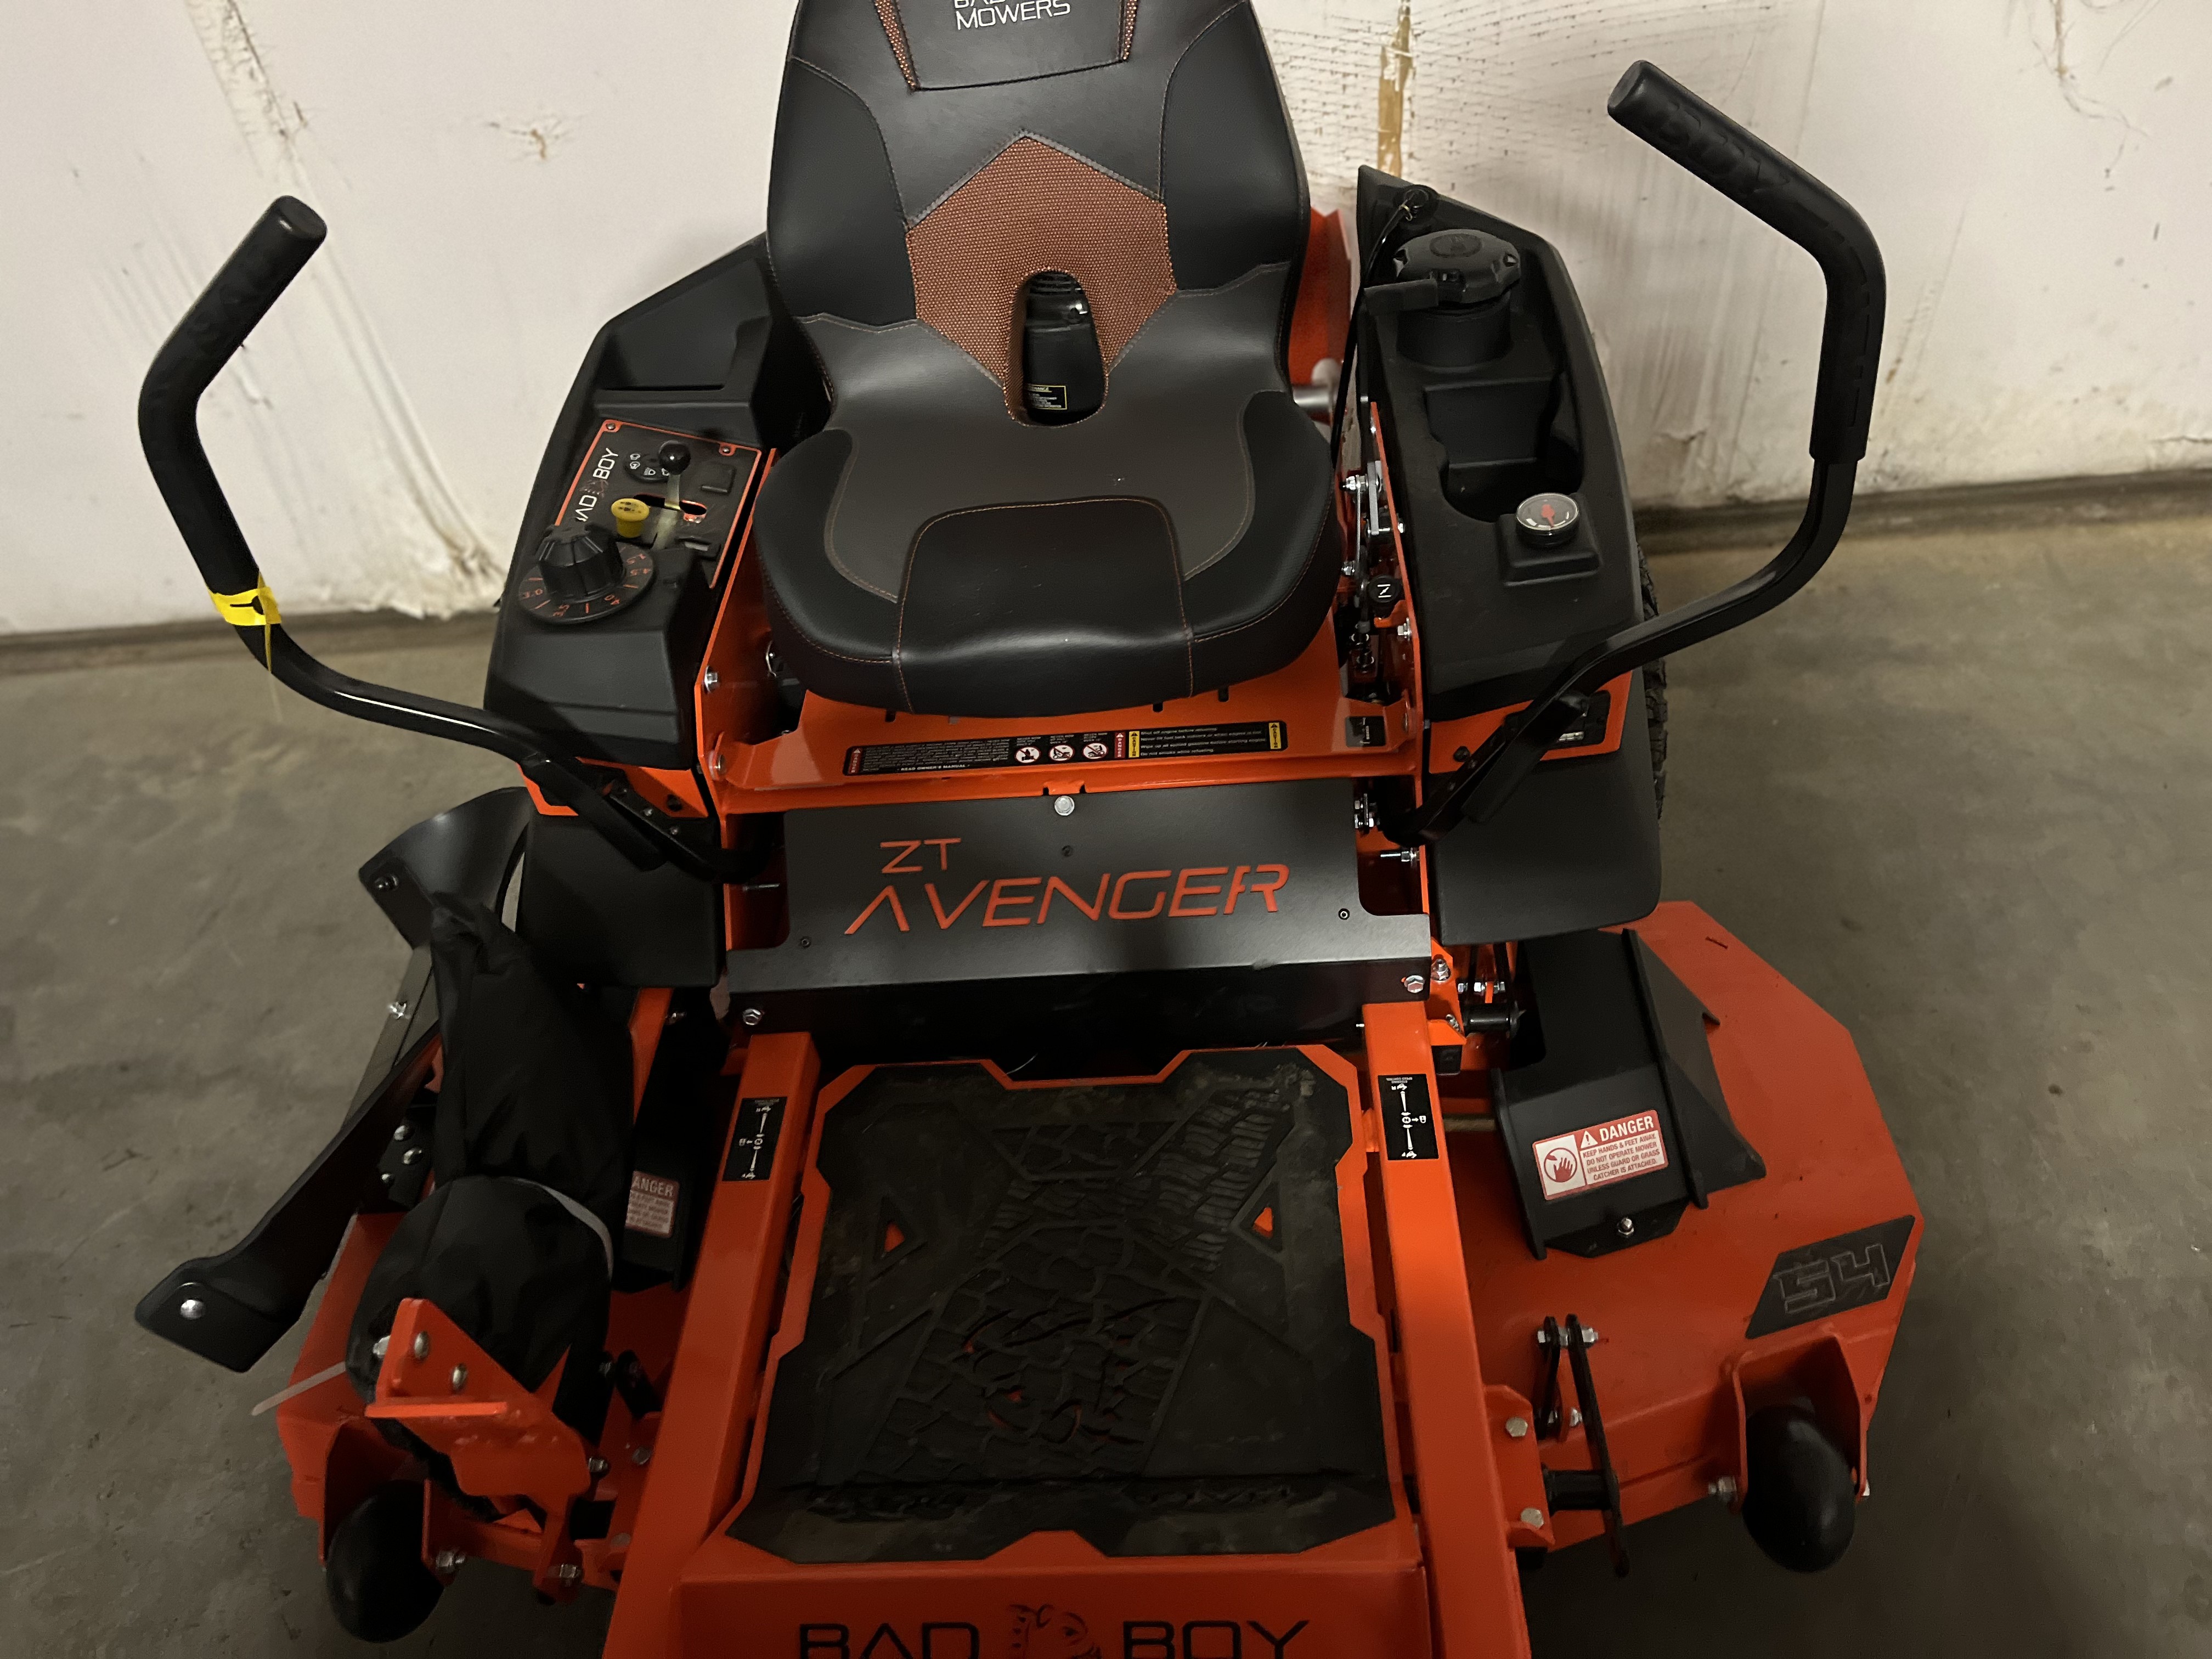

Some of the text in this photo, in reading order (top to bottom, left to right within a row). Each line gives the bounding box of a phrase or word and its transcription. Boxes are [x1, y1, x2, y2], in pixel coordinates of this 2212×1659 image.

[956, 0, 1070, 30] MOWERS
[575, 448, 618, 522] AD BOY
[880, 838, 961, 873] ZT
[844, 864, 1289, 935] AVENGER
[1599, 1115, 1654, 1142] DANGER
[1583, 1149, 1596, 1158] KEEP
[1599, 1144, 1618, 1154] HANDS
[1625, 1138, 1638, 1147] FEET
[1587, 1164, 1610, 1174] UNLESS
[1611, 1159, 1630, 1169] GUARD
[1641, 1149, 1660, 1159] GRASS
[1609, 1148, 1634, 1160] OPERATE
[1635, 1141, 1657, 1153] MOWER
[631, 1176, 673, 1196] ANGER
[1593, 1168, 1620, 1181] CATCHER
[1772, 1243, 1891, 1314] 54
[799, 1620, 1310, 1659] BAD BOY
